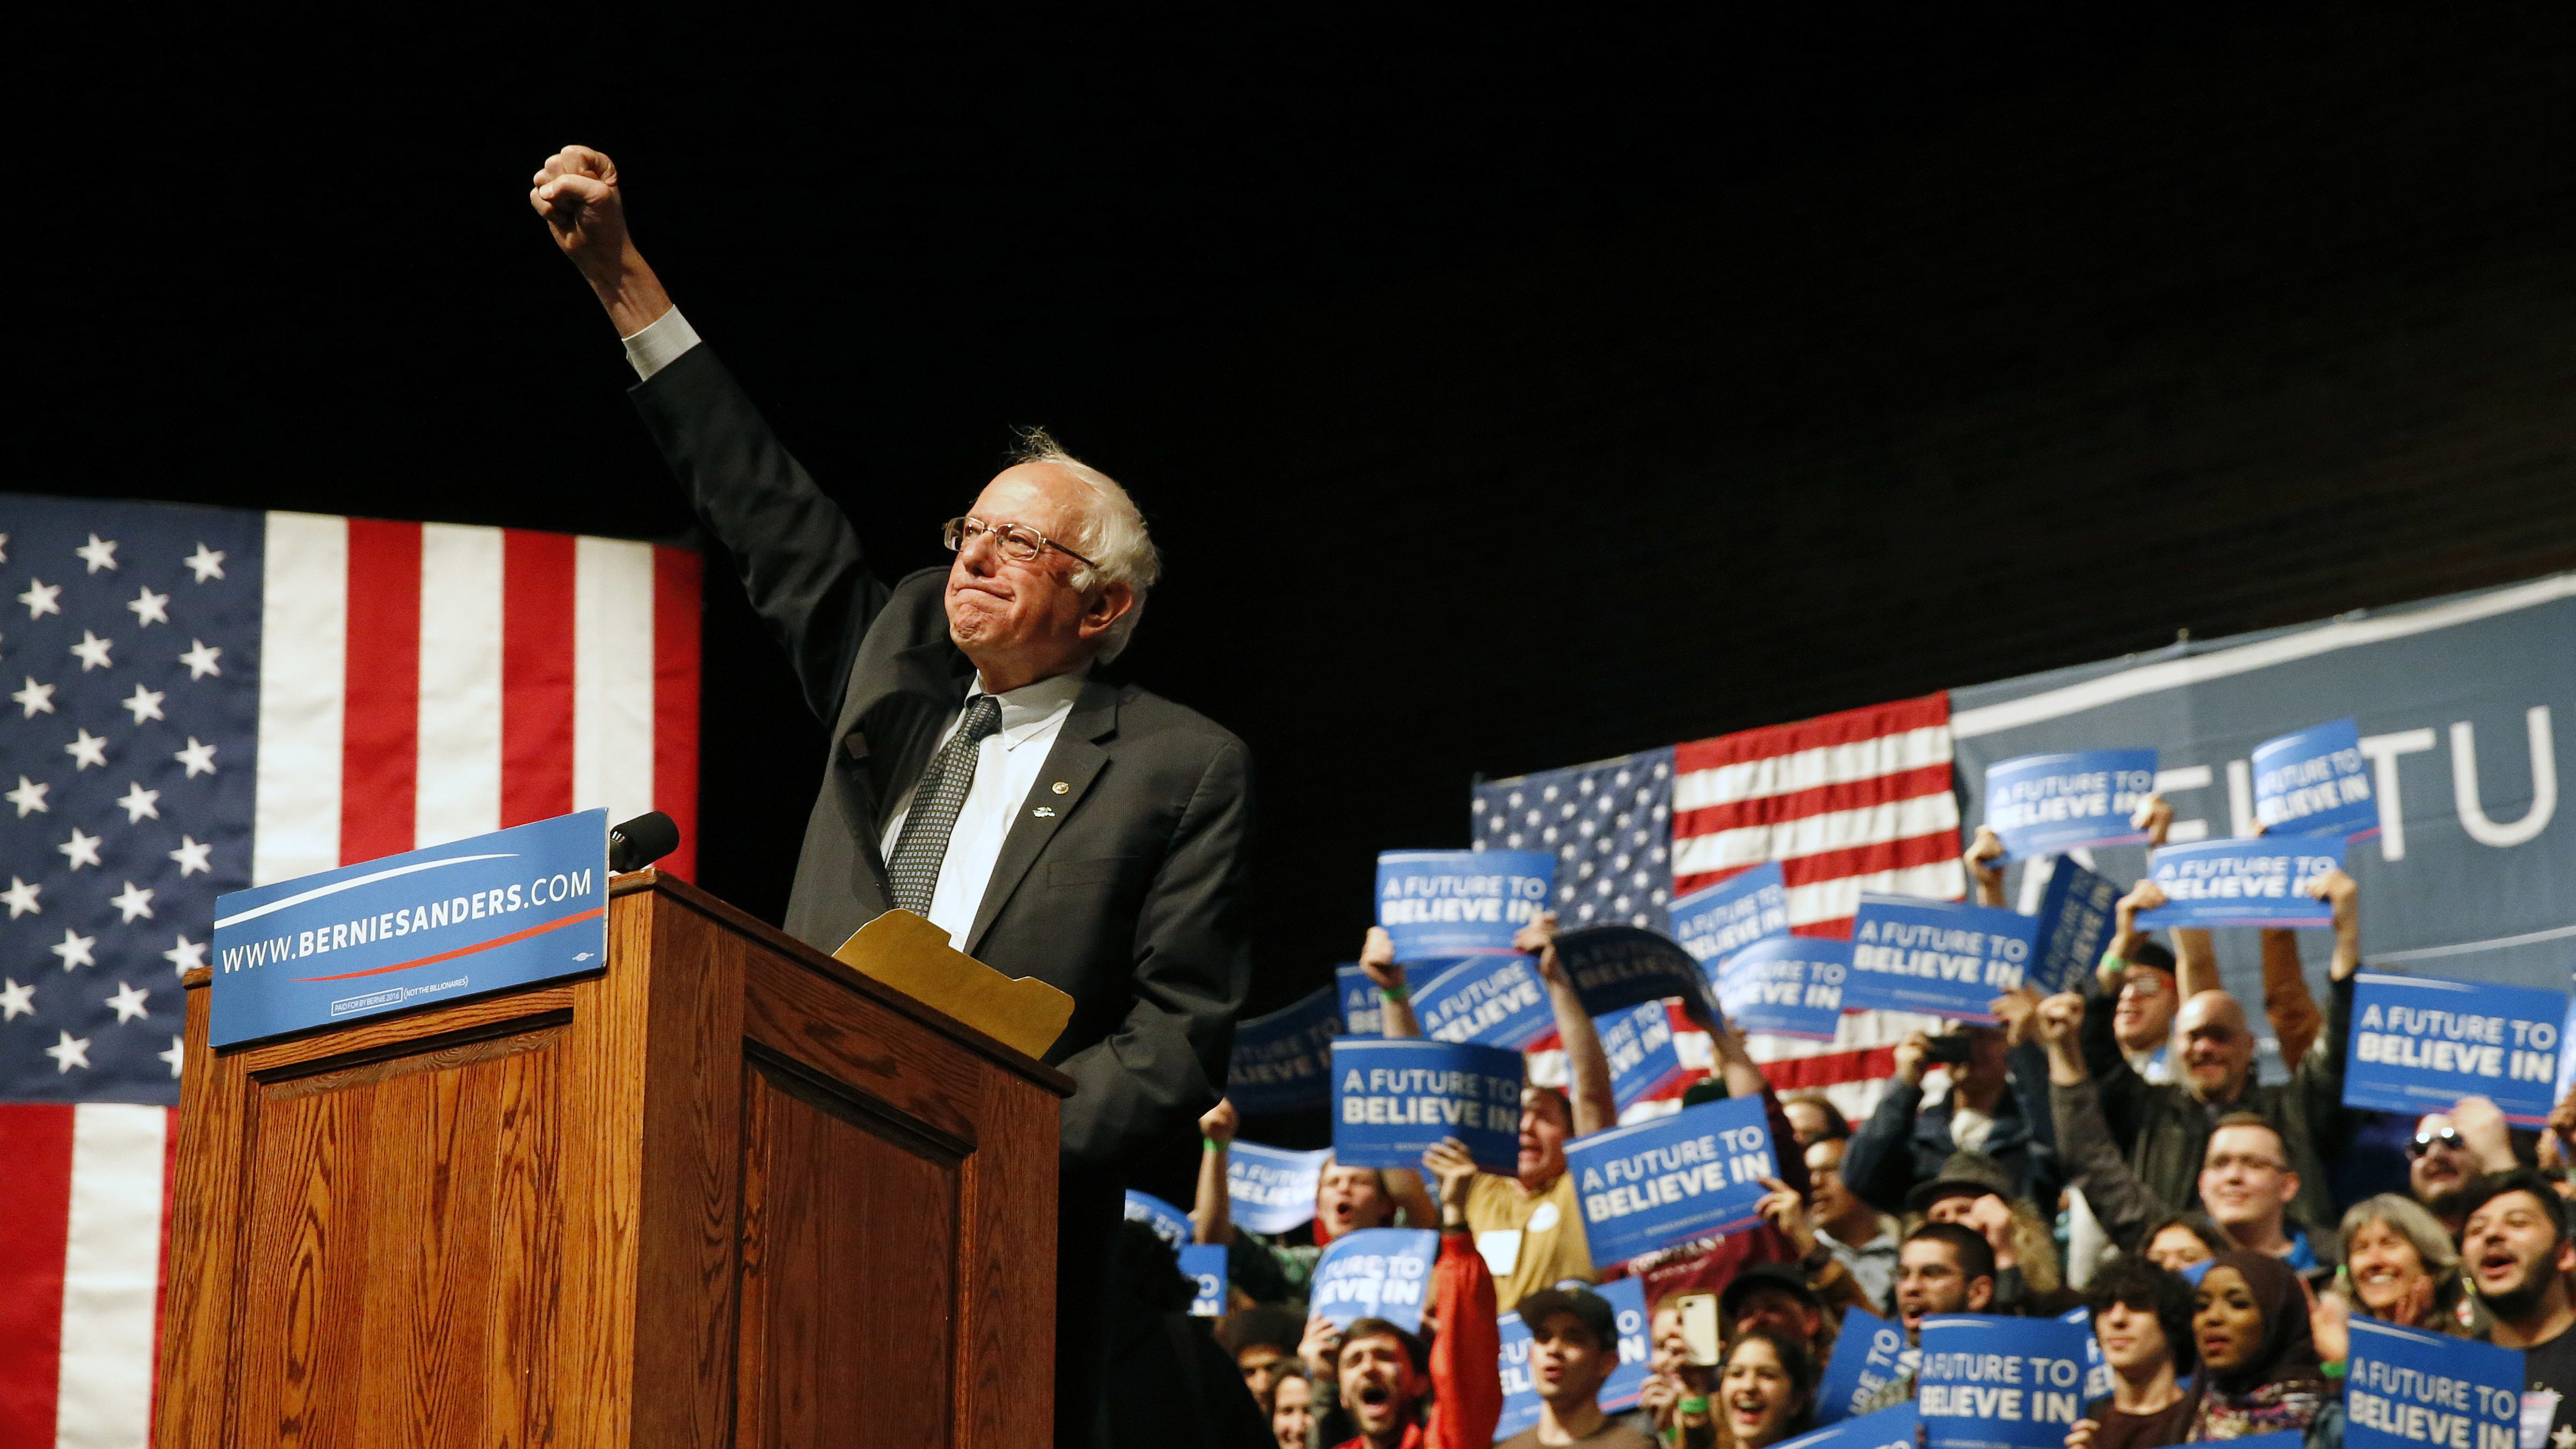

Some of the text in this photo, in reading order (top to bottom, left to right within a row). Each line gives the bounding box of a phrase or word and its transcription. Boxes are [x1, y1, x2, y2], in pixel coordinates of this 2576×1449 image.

[2332, 748, 2363, 775] TO
[1992, 770, 2153, 806] A FUTURE TO
[2338, 773, 2371, 805] IN
[1990, 792, 2109, 832] BELIEVE
[2156, 856, 2338, 880] A FUTURE TO
[1383, 875, 1547, 900] A FUTURE TO
[222, 868, 591, 974] WWW.BERNIESANDERS.COM
[1381, 897, 1503, 926] BELIEVE
[1692, 893, 1758, 933] FUTURE
[1757, 883, 1784, 908] TO
[1761, 907, 1787, 932] IN
[1859, 920, 2029, 962] A FUTURE TO
[1809, 961, 1847, 986] TO
[1854, 944, 2025, 989] BELIEVE IN
[335, 1003, 347, 1011] PAID
[347, 1001, 359, 1009] FOR
[359, 999, 367, 1007] BY
[366, 995, 386, 1005] BERNIE
[386, 992, 400, 1001] 2016
[419, 985, 430, 994] THE
[1348, 988, 1367, 1007] A
[1425, 1010, 1443, 1032] A
[1439, 960, 1530, 1021] FUTURE
[1804, 984, 1844, 1011] IN
[2361, 1003, 2558, 1050] A FUTURE TO
[2356, 1031, 2556, 1084] BELIEVE IN
[1343, 1068, 1519, 1103] A FUTURE TO
[1343, 1096, 1519, 1134] BELIEVE IN
[1582, 1125, 1765, 1193] A FUTURE TO
[1585, 1161, 1728, 1223] BELIEVE
[1729, 1151, 1772, 1185] IN
[1387, 1255, 1425, 1280] TO
[1381, 1278, 1421, 1306] IN
[1866, 1329, 1900, 1367] TO
[2028, 1357, 2079, 1388] TO
[2350, 1357, 2517, 1421] A FUTURE TO
[2031, 1390, 2078, 1424] IN
[2348, 1389, 2471, 1449] BELIEVE
